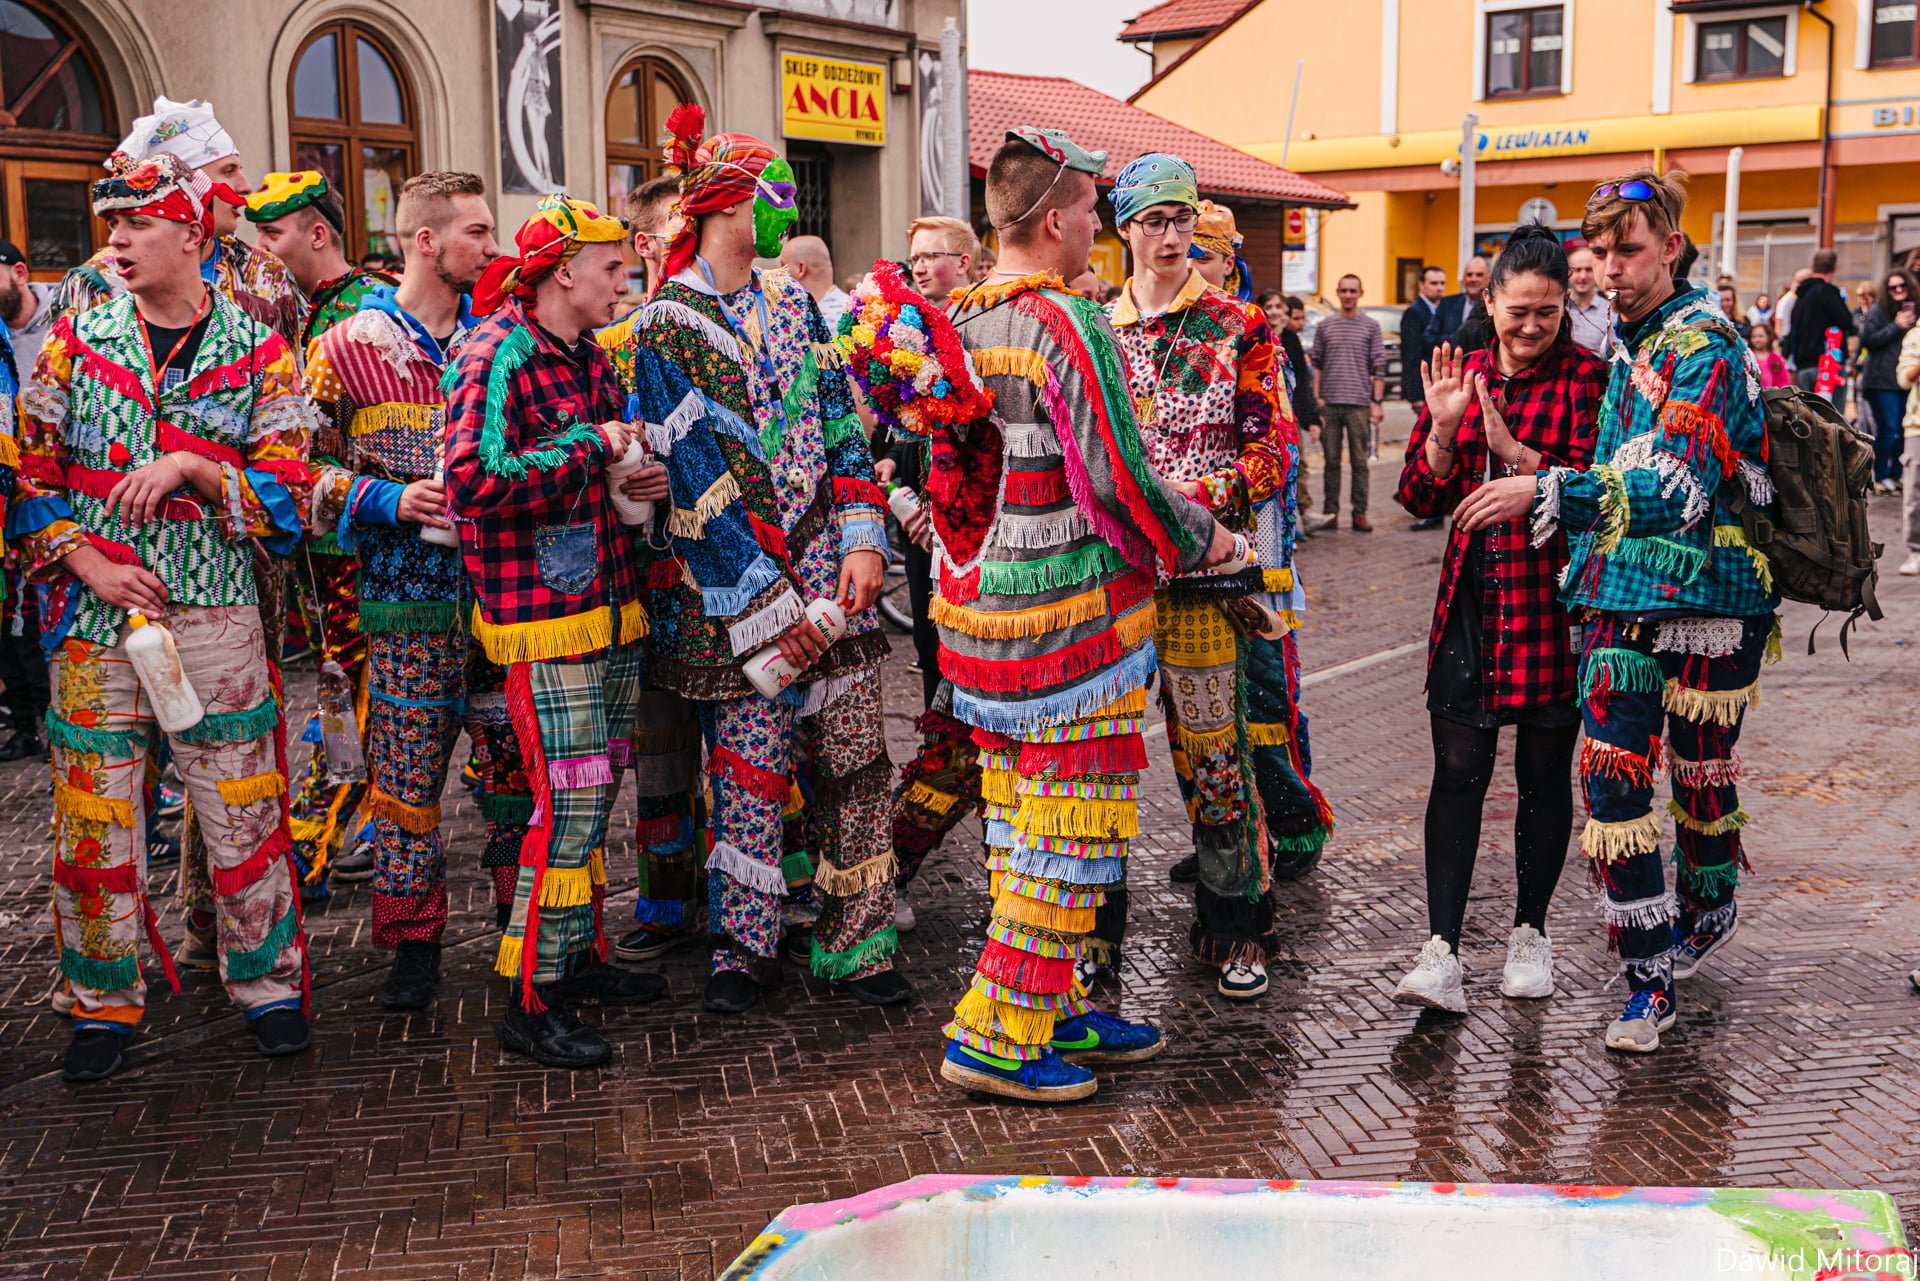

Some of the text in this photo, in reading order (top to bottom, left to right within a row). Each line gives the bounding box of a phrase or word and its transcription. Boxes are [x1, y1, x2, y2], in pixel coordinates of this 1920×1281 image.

[785, 59, 881, 86] SKLEP ODZIEŻOWY
[786, 81, 880, 122] ANCIA
[1872, 106, 1920, 126] BI
[1496, 129, 1589, 151] LEWIATAN
